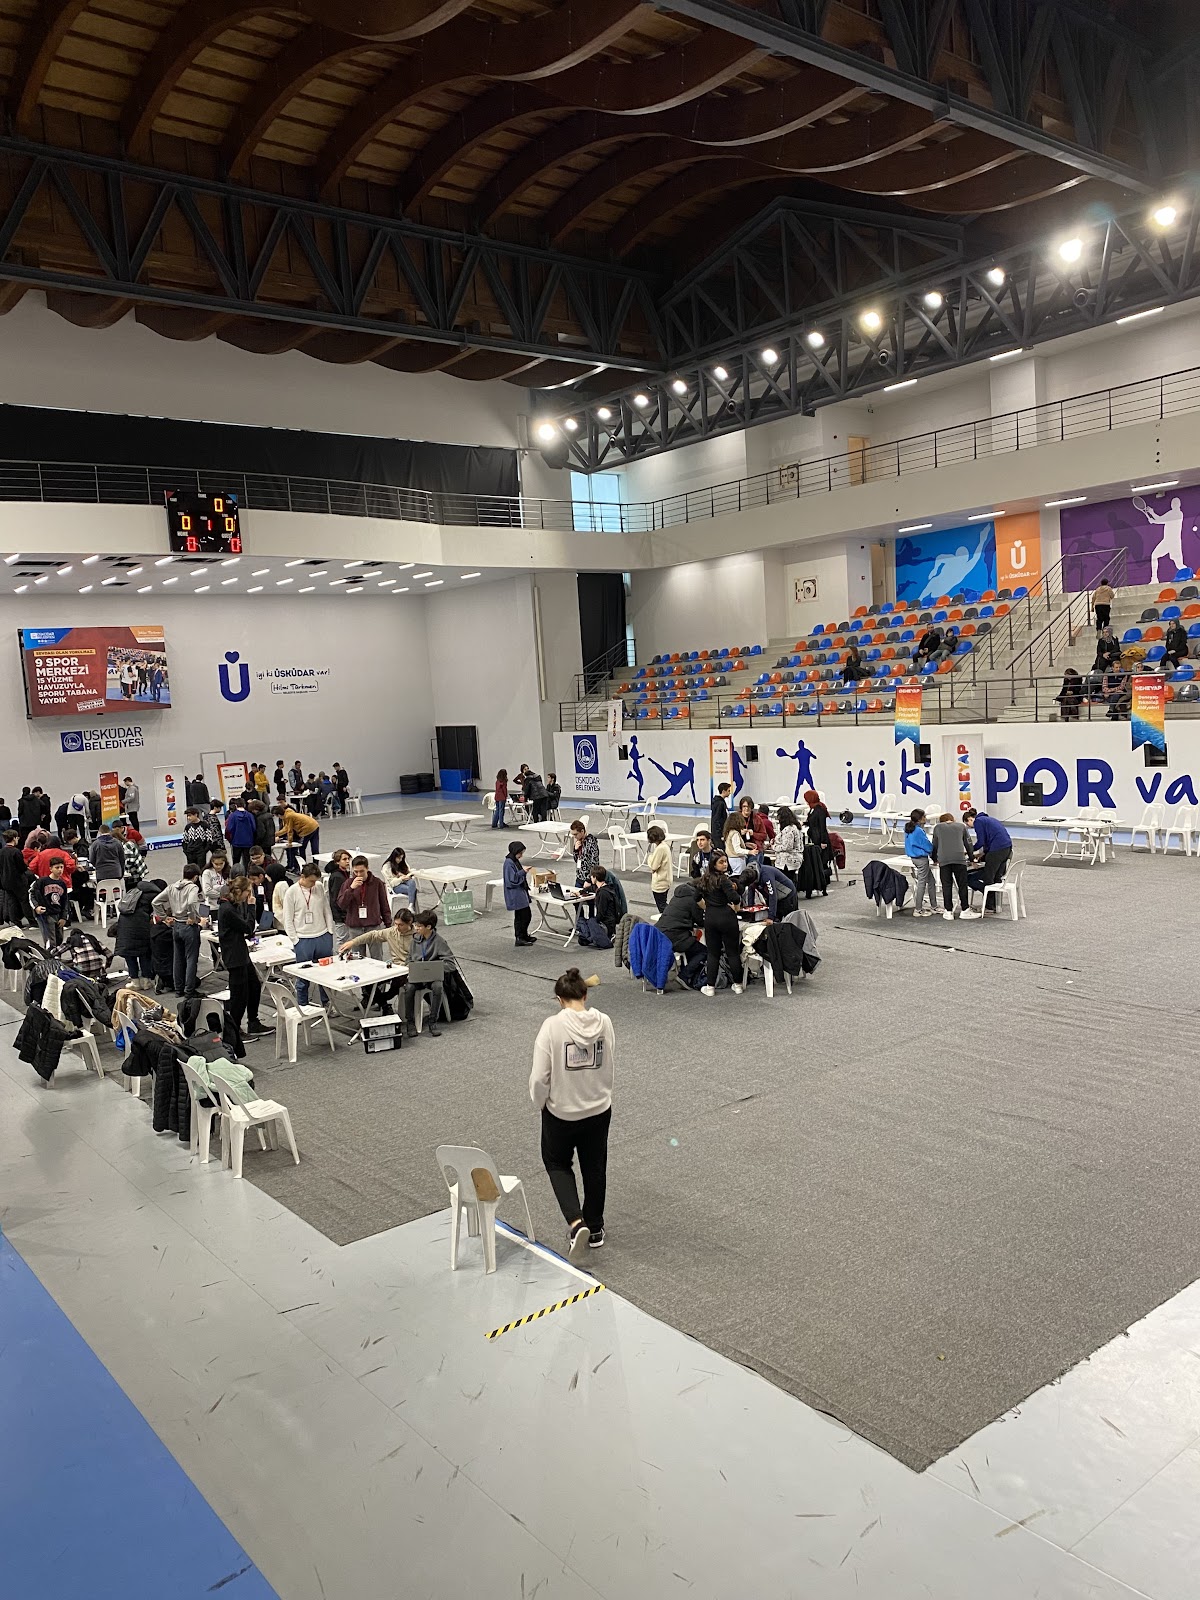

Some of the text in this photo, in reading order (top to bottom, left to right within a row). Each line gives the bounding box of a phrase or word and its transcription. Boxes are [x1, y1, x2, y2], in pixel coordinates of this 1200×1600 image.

[214, 498, 223, 512] 0
[182, 516, 190, 530] 0
[226, 518, 233, 531] 0
[188, 537, 196, 551] 0
[231, 538, 239, 552] 0
[35, 657, 78, 667] 9 SPOR
[36, 664, 89, 676] MERKEZİ
[256, 672, 264, 680] iyi
[274, 668, 314, 677] ÜSKÜDAR
[83, 727, 142, 741] ÜSKÜDAR
[846, 760, 886, 810] iyi
[900, 748, 931, 795] ki
[985, 757, 1116, 808] POR
[957, 745, 972, 811] DENEYAP
[165, 774, 177, 826] DENEYAP
